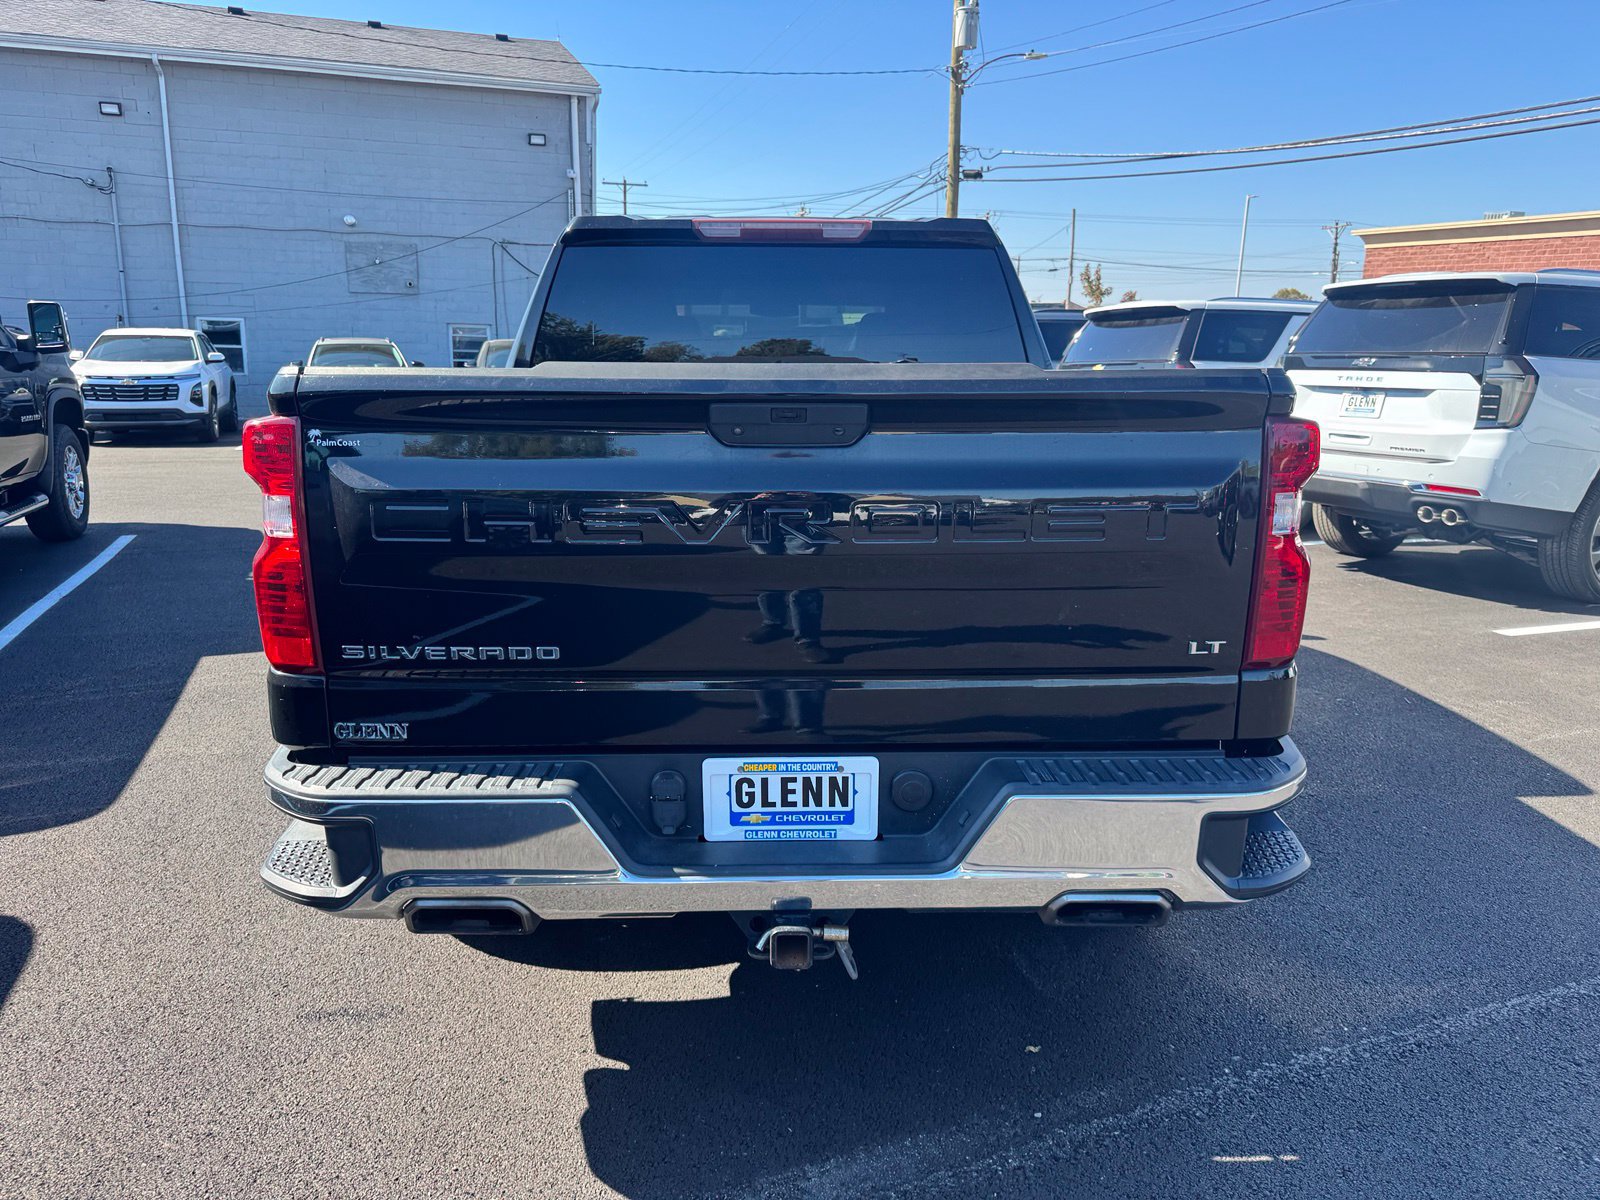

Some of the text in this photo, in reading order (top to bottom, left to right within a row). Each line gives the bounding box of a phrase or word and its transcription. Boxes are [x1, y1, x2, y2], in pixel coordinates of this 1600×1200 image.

[1348, 396, 1377, 408] GLENN
[316, 439, 361, 447] PalmCoast
[370, 499, 1200, 545] CHEVROLET
[341, 645, 561, 661] SILVERADO
[1188, 640, 1227, 655] LT
[333, 722, 410, 741] GLENN
[743, 763, 838, 772] CHEAPER IN THE COUNTRY.
[735, 776, 850, 809] GLENN
[775, 814, 846, 822] CHEVROLET
[746, 830, 836, 839] GLENN CHEVROLET
